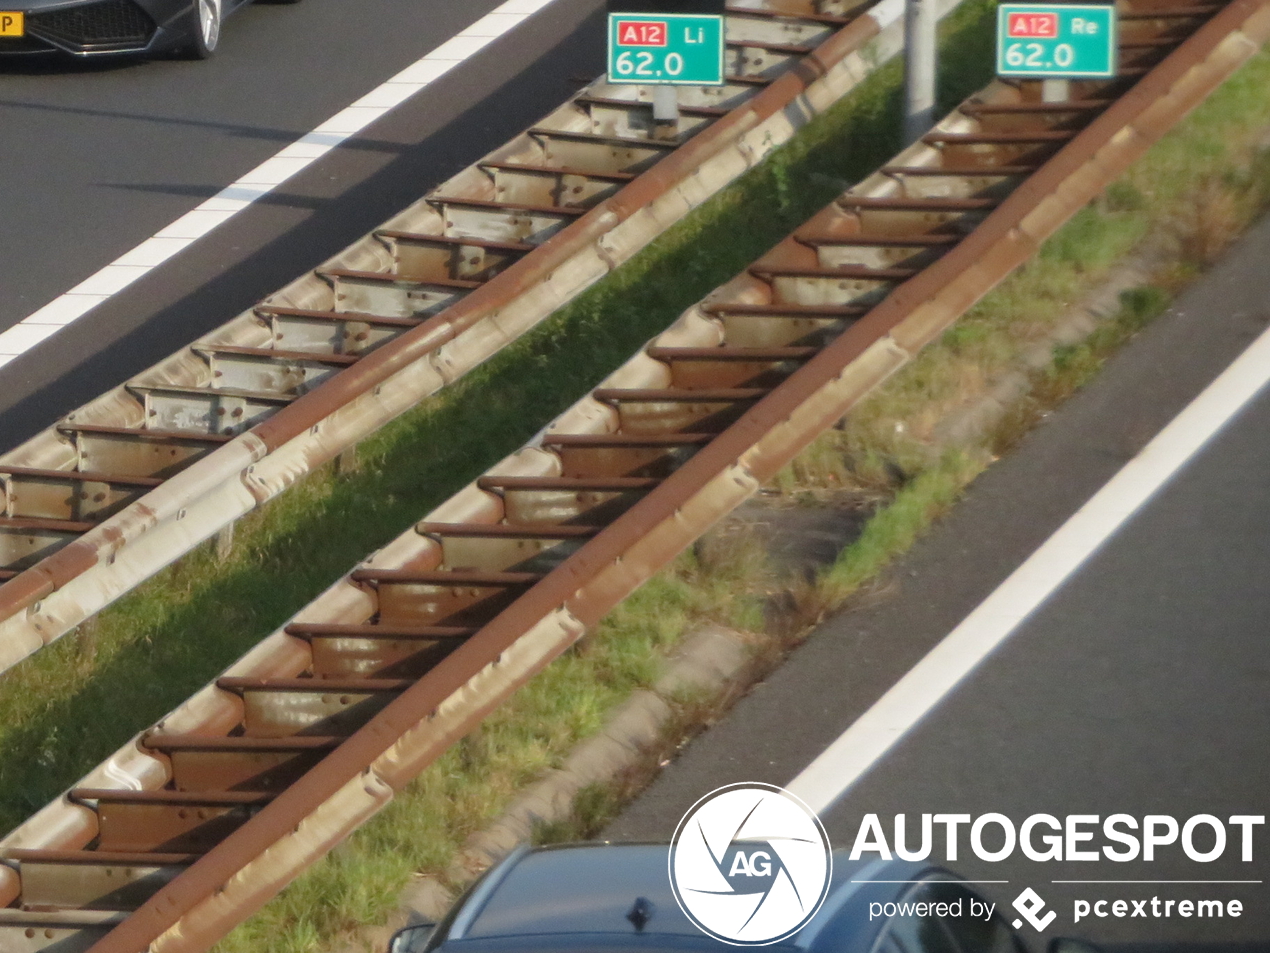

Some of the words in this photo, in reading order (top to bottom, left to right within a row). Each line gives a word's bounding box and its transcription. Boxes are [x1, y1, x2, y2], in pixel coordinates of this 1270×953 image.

[622, 25, 661, 43] A12
[684, 26, 704, 44] Li
[1012, 17, 1051, 35] A12
[1071, 17, 1099, 35] Re
